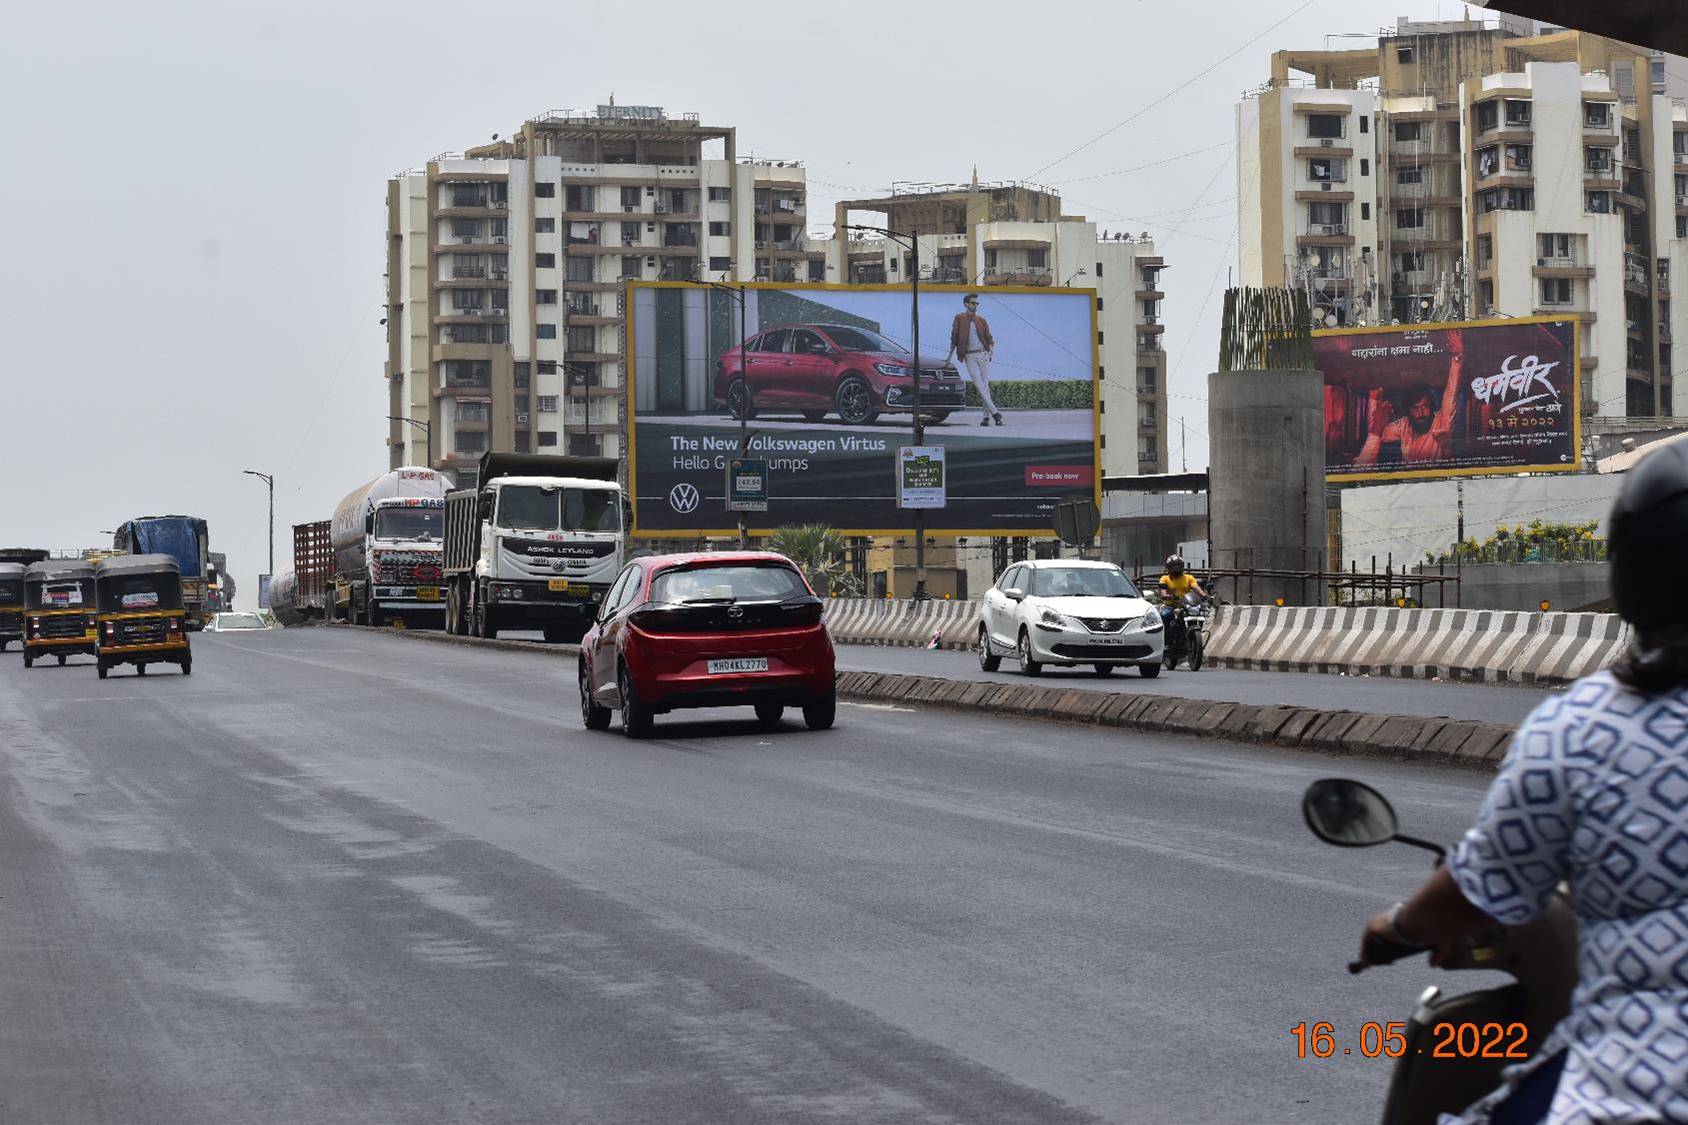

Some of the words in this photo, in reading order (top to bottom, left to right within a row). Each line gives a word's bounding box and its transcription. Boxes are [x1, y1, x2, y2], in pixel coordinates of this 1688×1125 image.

[1470, 354, 1560, 405] धर्मवीर
[1521, 417, 1554, 426] २०२२
[670, 436, 699, 450] The
[702, 436, 738, 450] New
[840, 437, 886, 450] Virtus
[673, 456, 710, 470] Hello
[714, 455, 809, 472] Gumps
[1031, 472, 1062, 480] Pre-book
[713, 660, 767, 671] MH04KL2770
